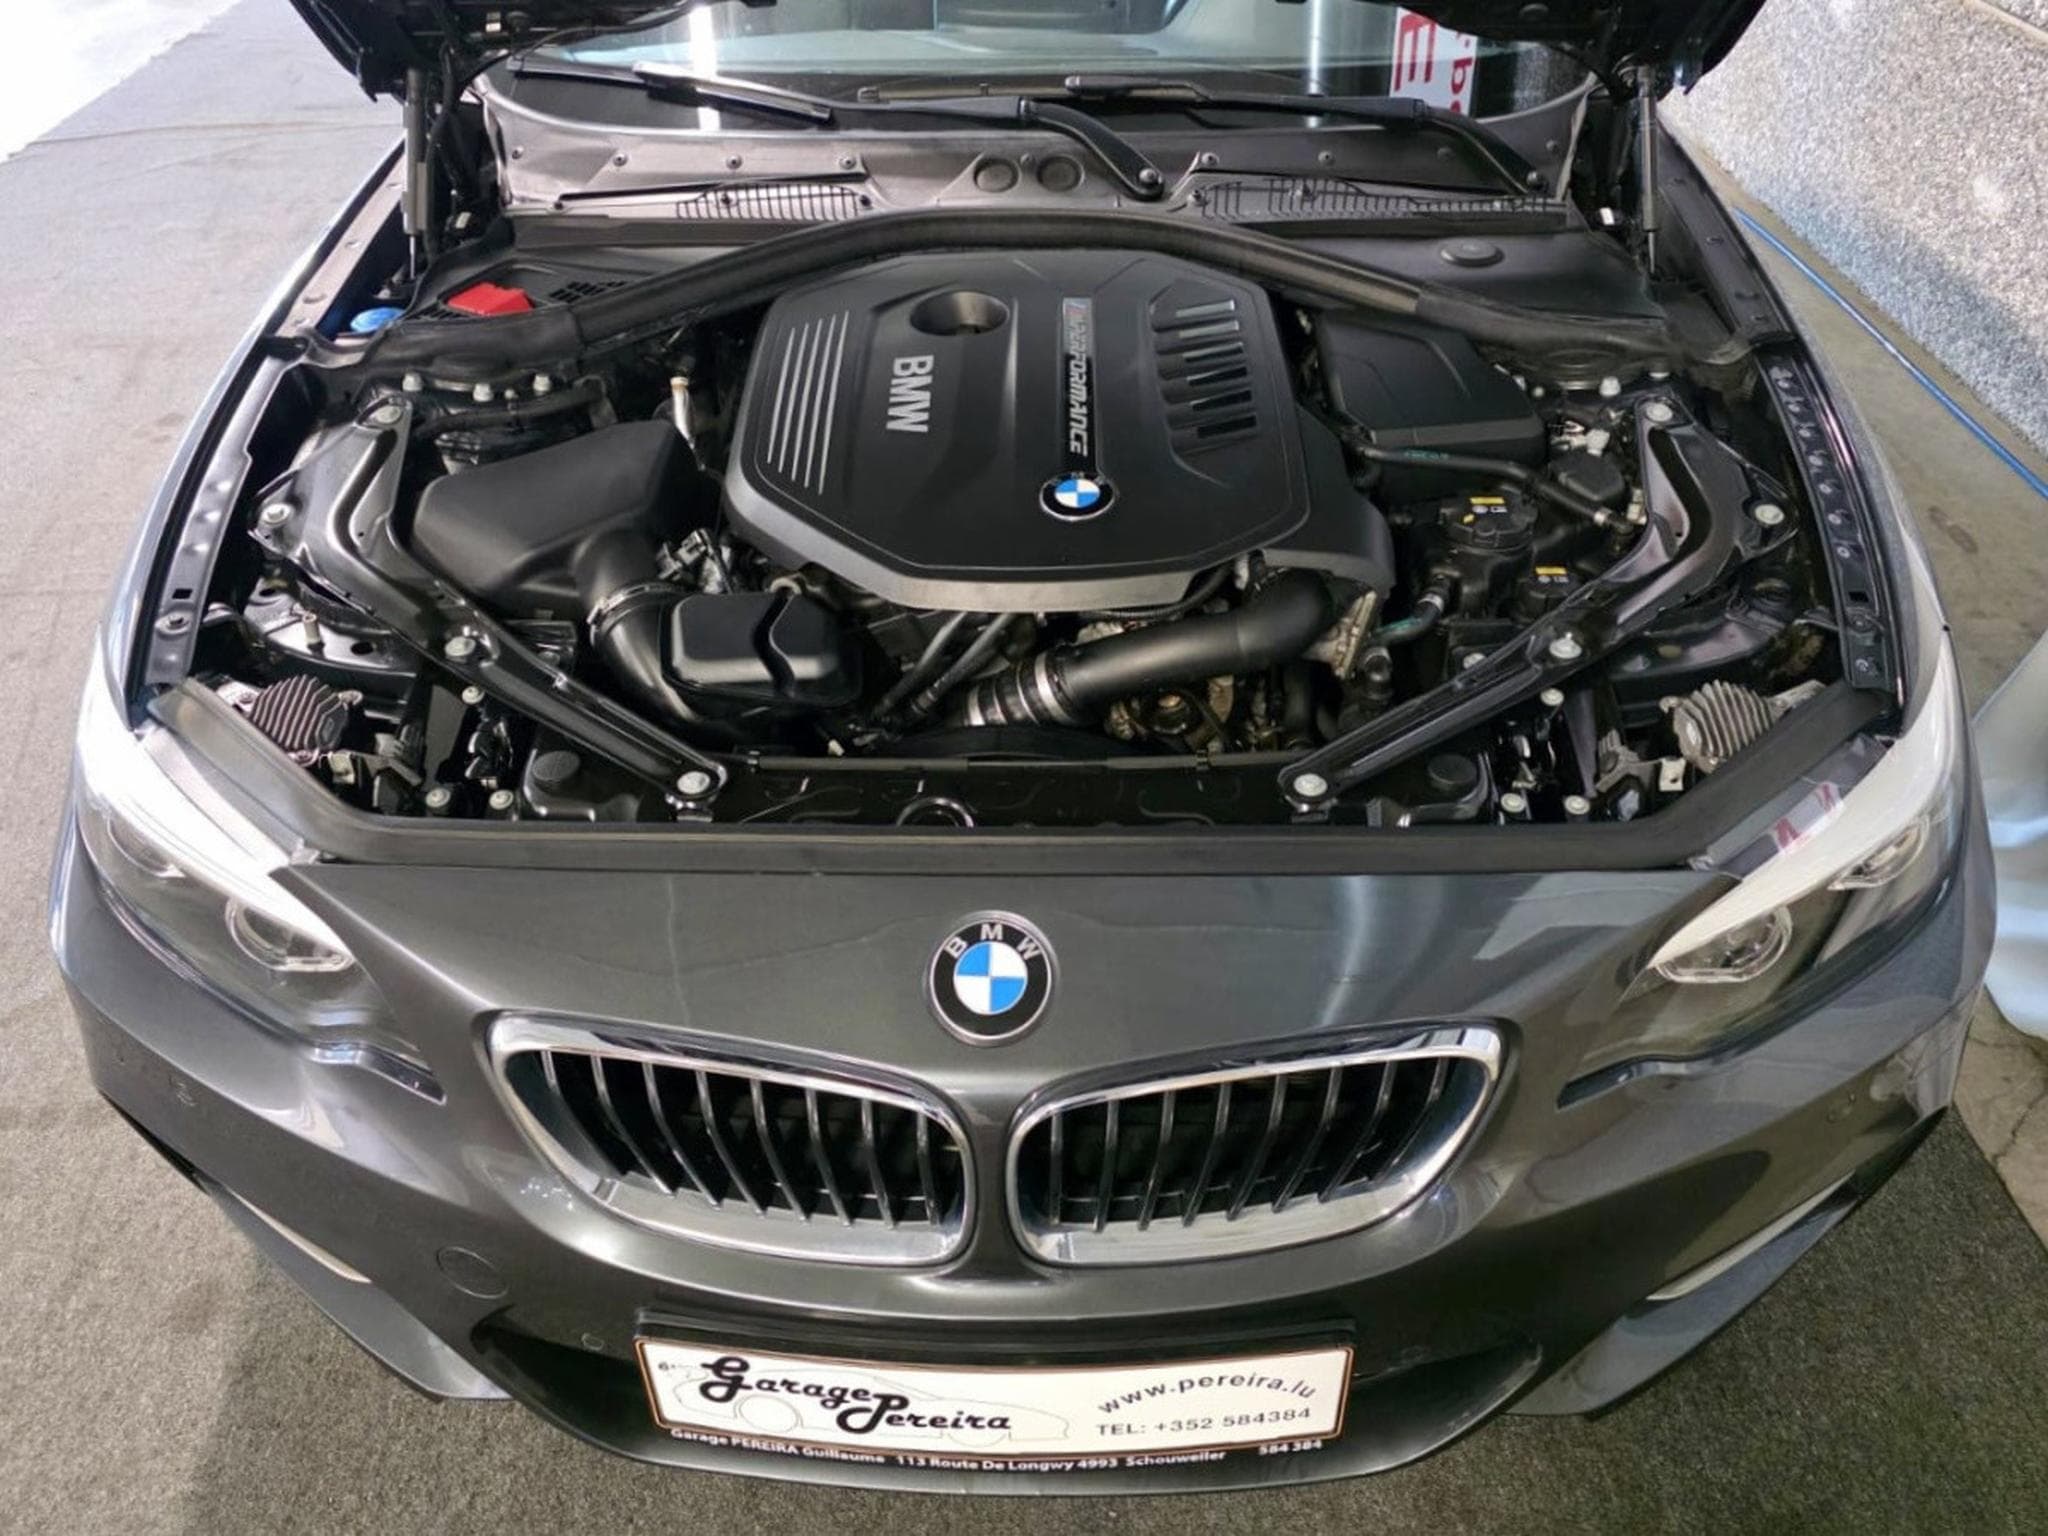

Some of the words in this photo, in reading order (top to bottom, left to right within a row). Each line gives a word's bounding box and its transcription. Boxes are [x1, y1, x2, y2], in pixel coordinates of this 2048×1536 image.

[886, 355, 934, 432] BMW
[943, 923, 1041, 960] BMW
[700, 1356, 873, 1410] Garage
[1098, 1372, 1316, 1414] www.pereira.lu
[836, 1393, 1011, 1434] Pereira
[1097, 1423, 1145, 1436] TEL:
[1154, 1417, 1213, 1433] +352
[1222, 1407, 1311, 1427] 584384
[671, 1428, 728, 1446] Garage
[731, 1437, 799, 1455] PEREIRA
[982, 1460, 1005, 1470] De
[1008, 1460, 1074, 1472] Longwy
[1077, 1457, 1118, 1469] 4993
